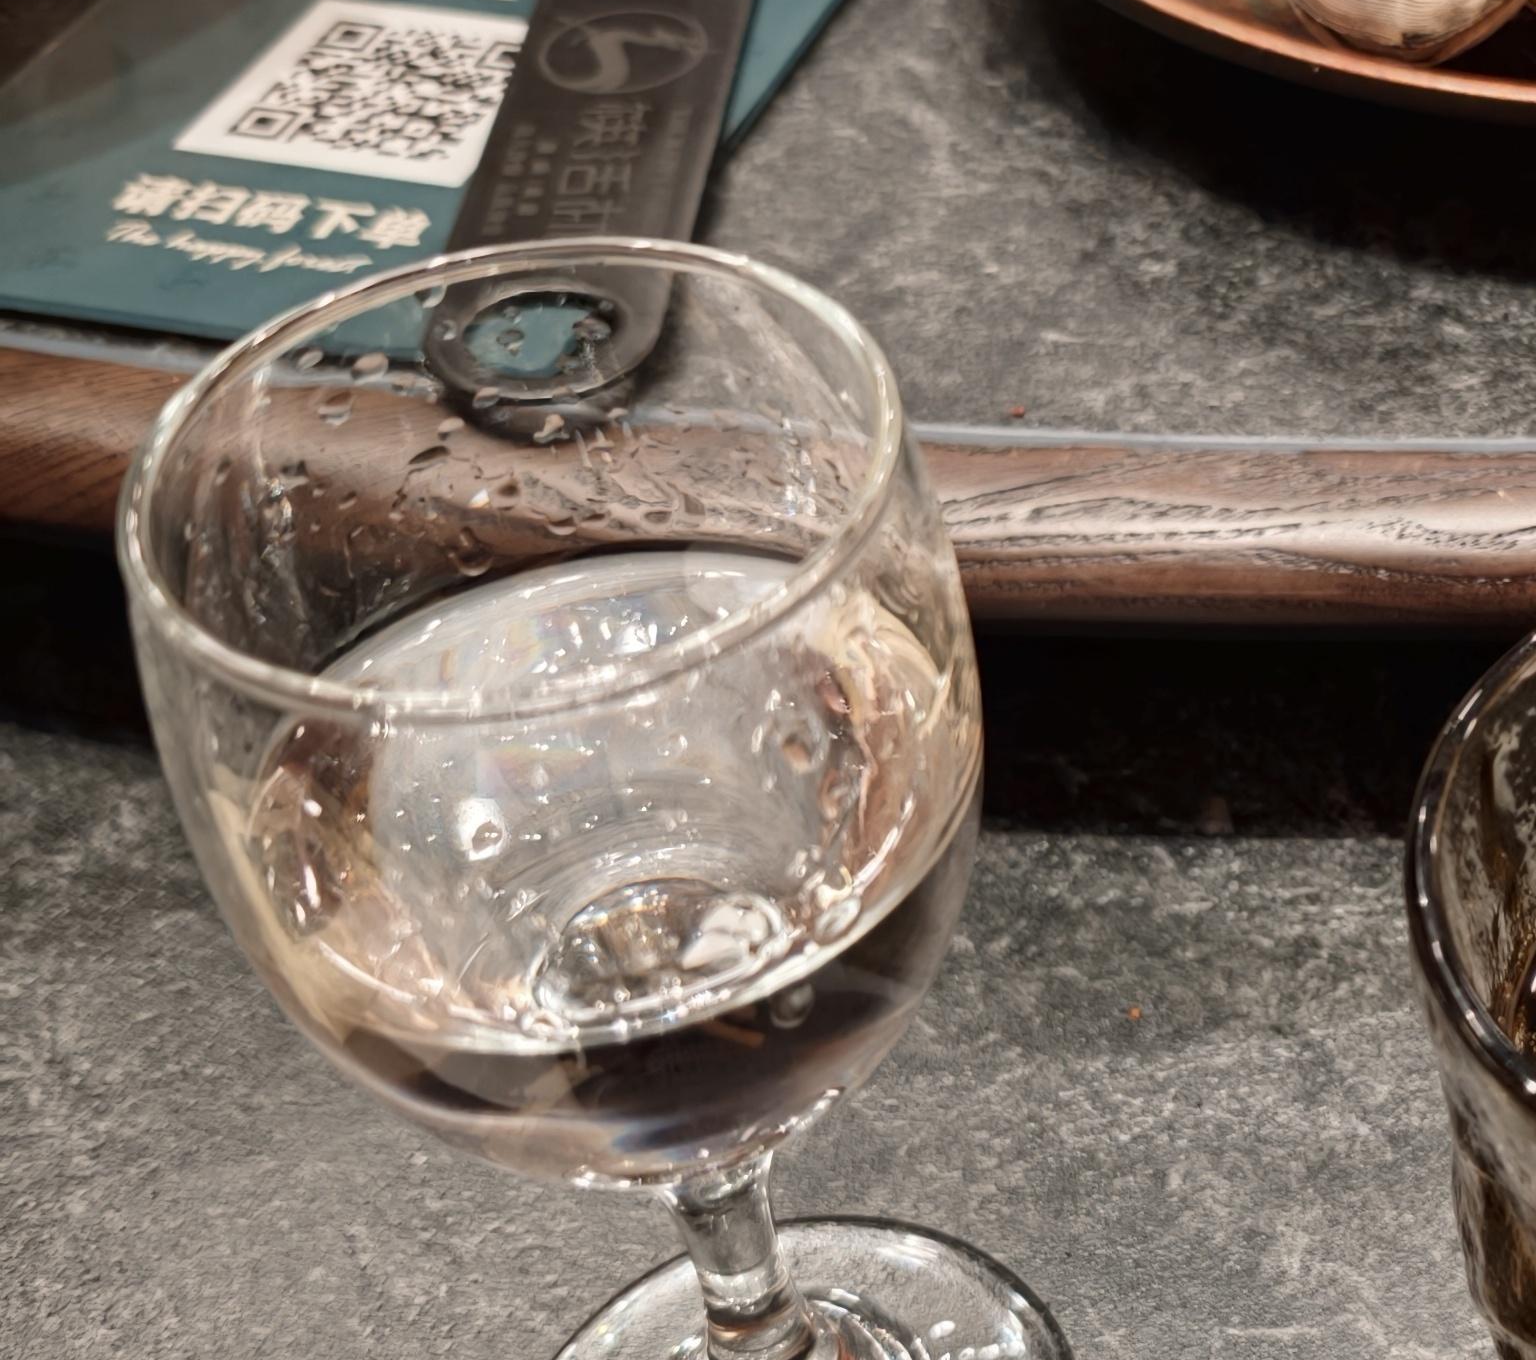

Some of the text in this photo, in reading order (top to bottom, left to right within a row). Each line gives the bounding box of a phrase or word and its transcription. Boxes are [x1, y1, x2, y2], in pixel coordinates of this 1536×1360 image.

[111, 173, 432, 250] 请扫码下单
